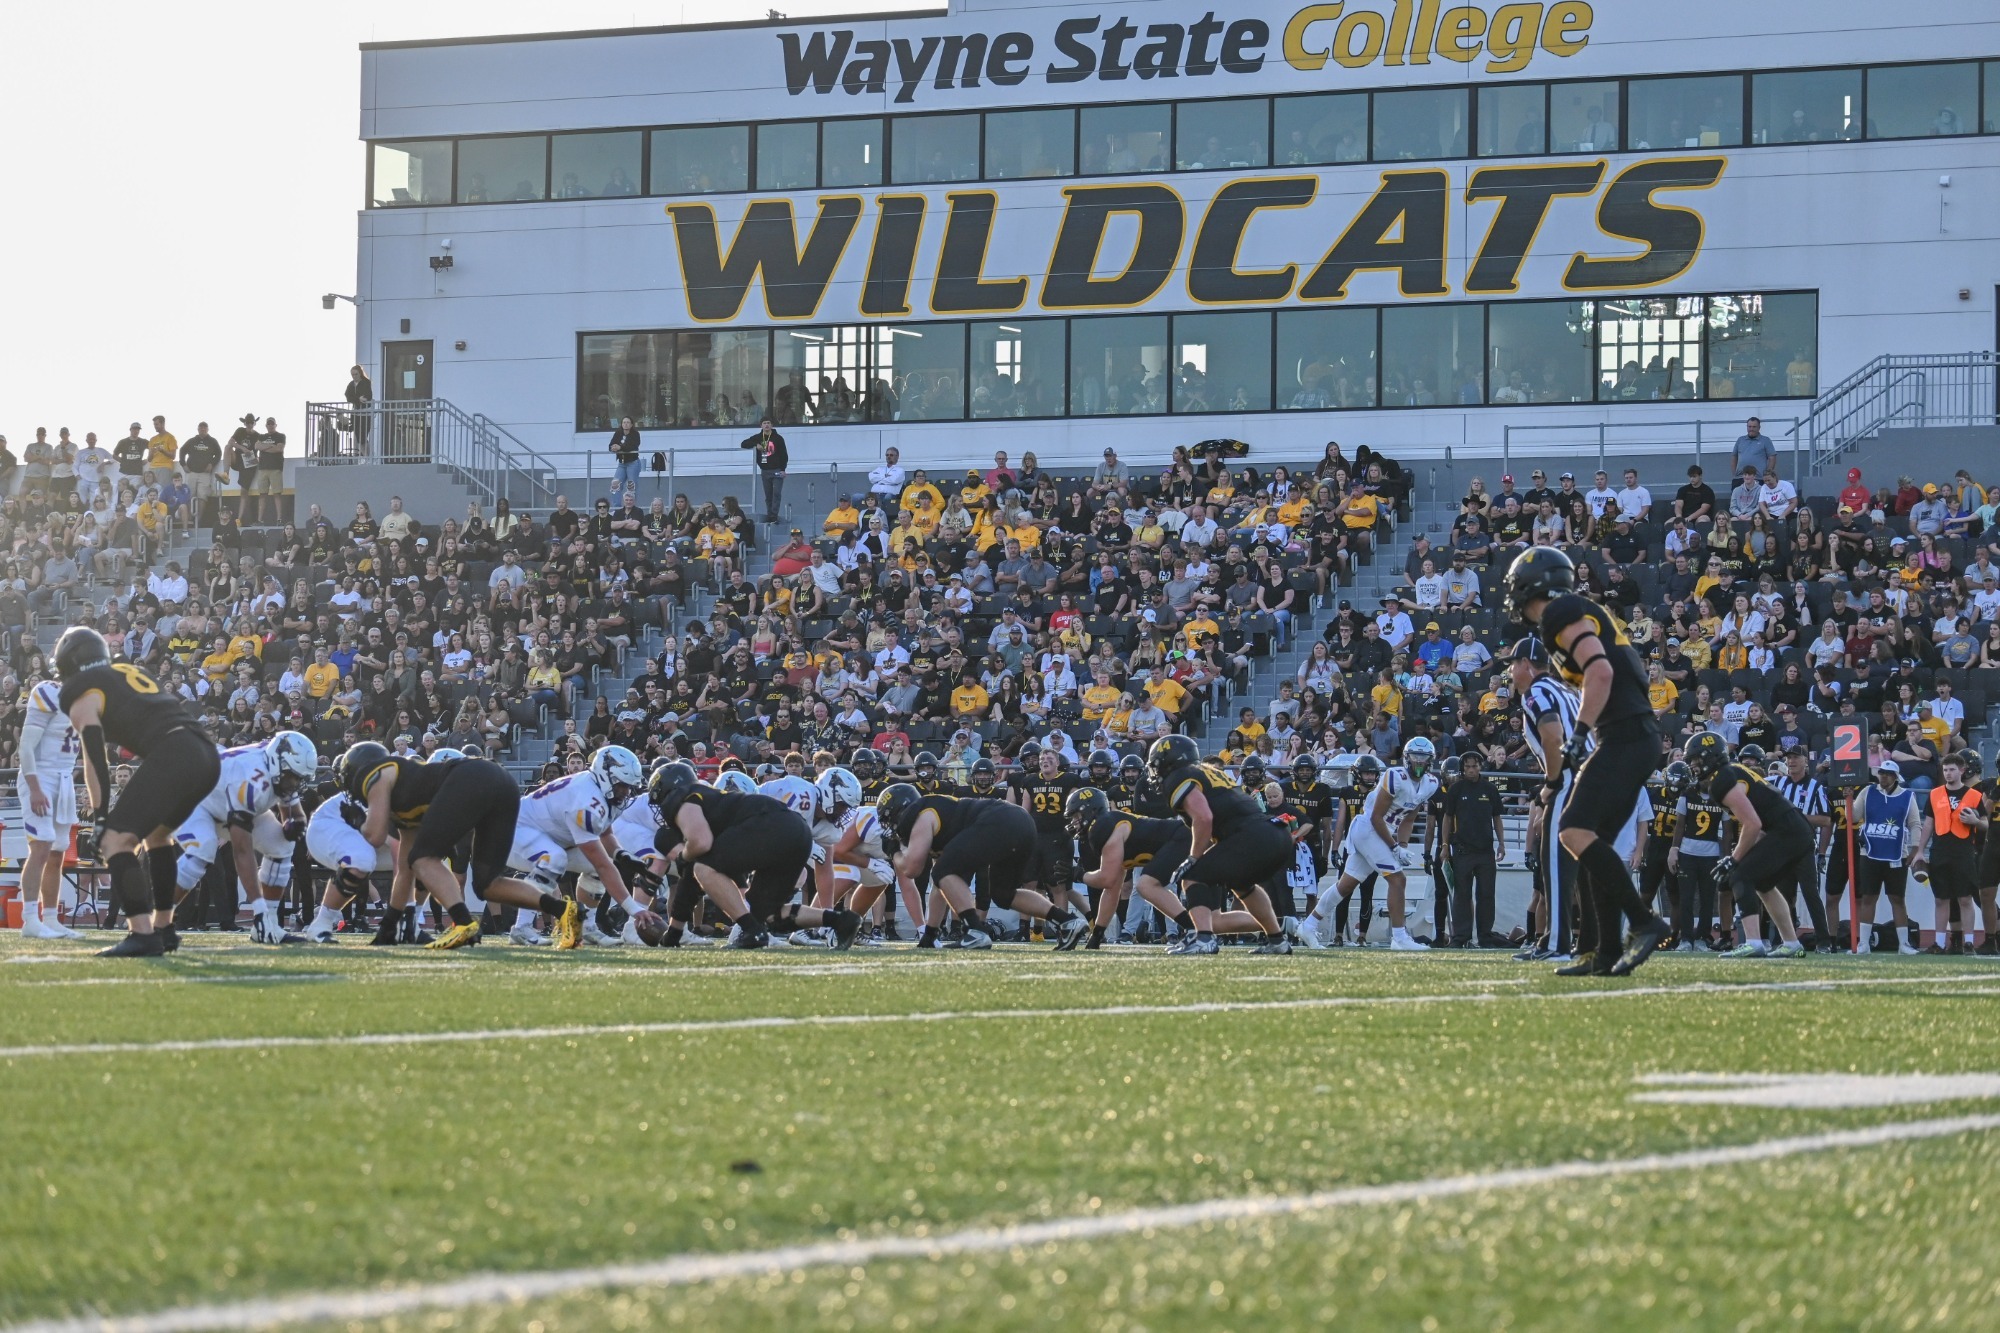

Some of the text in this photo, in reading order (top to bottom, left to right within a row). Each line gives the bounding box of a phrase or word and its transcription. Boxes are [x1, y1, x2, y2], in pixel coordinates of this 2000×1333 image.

[776, 0, 1593, 103] Wayne State College
[664, 155, 1728, 323] WILDCATS
[416, 354, 425, 365] 9
[110, 663, 159, 693] 8
[1701, 735, 1715, 746] 49
[1834, 725, 1861, 760] 2
[1034, 793, 1061, 814] 93
[1079, 789, 1093, 800] 48
[1653, 812, 1677, 837] 45
[1695, 811, 1710, 836] 9
[1866, 822, 1900, 837] NSIC
